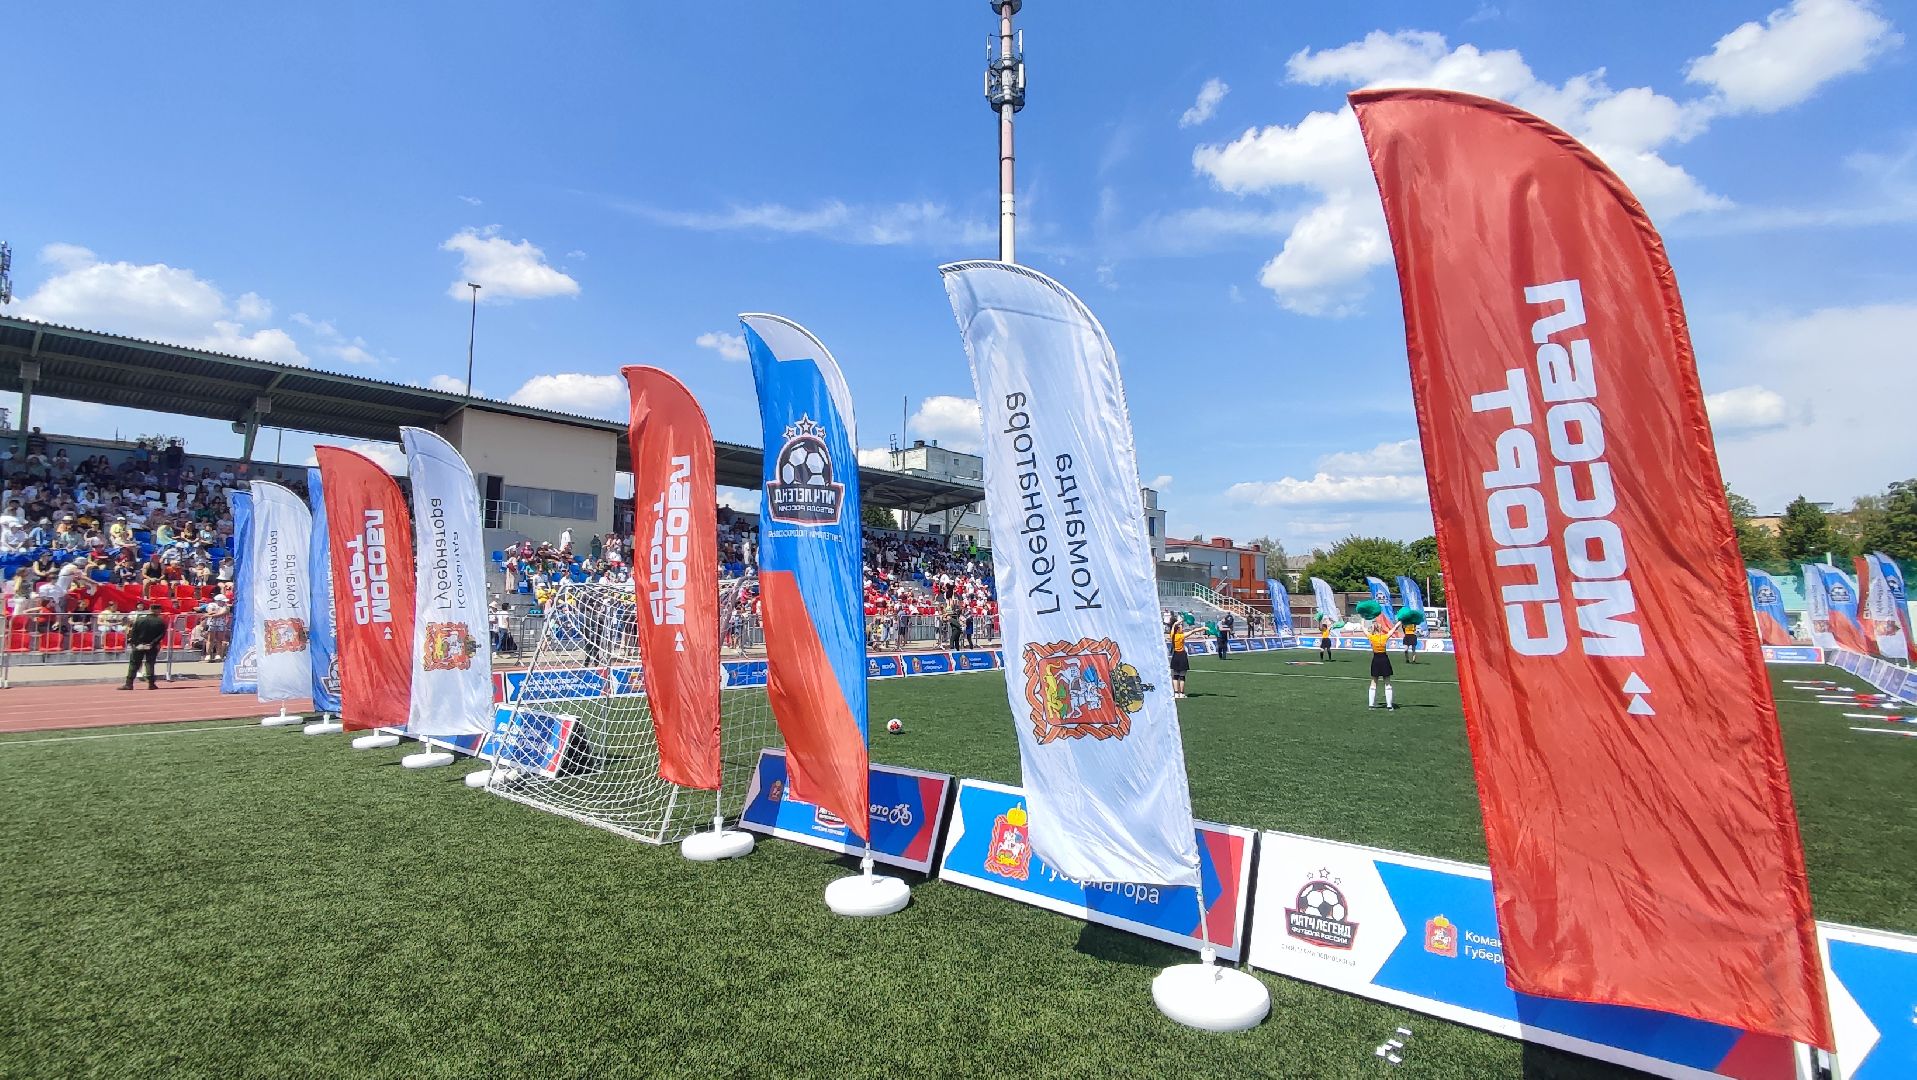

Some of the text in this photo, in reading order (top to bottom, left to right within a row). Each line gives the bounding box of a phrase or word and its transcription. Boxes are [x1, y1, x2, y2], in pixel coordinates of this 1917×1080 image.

[1290, 914, 1352, 938] МАТЧ ЛЕГЕНД
[1321, 933, 1348, 944] РОССИИ
